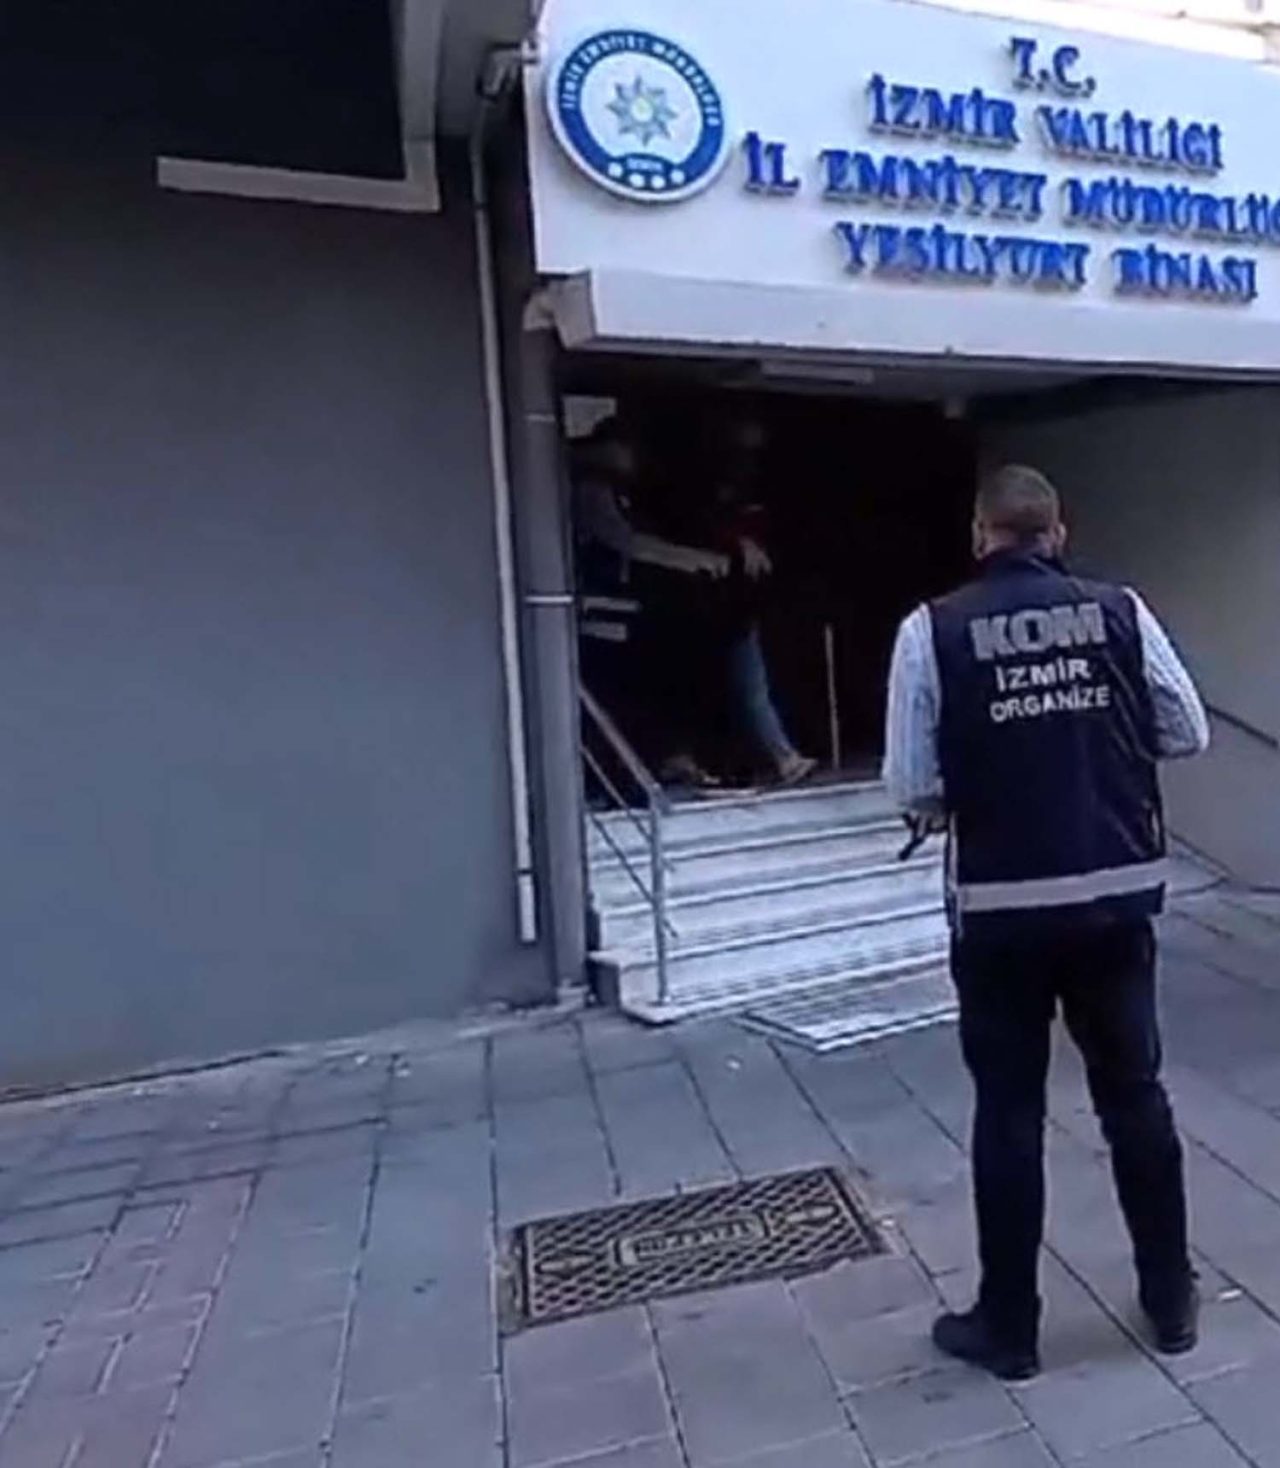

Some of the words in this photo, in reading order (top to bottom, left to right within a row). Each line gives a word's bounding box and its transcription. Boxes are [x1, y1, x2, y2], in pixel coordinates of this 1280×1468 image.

[1009, 36, 1096, 98] T.C.
[868, 73, 1022, 148] İZMİR
[742, 131, 800, 196] İL
[819, 149, 1047, 222] EMNİYET
[1110, 245, 1258, 303] BİNASI
[969, 602, 1107, 661] KOM
[990, 684, 1110, 722] ORGANİZE
[995, 656, 1091, 692] İZMİR
